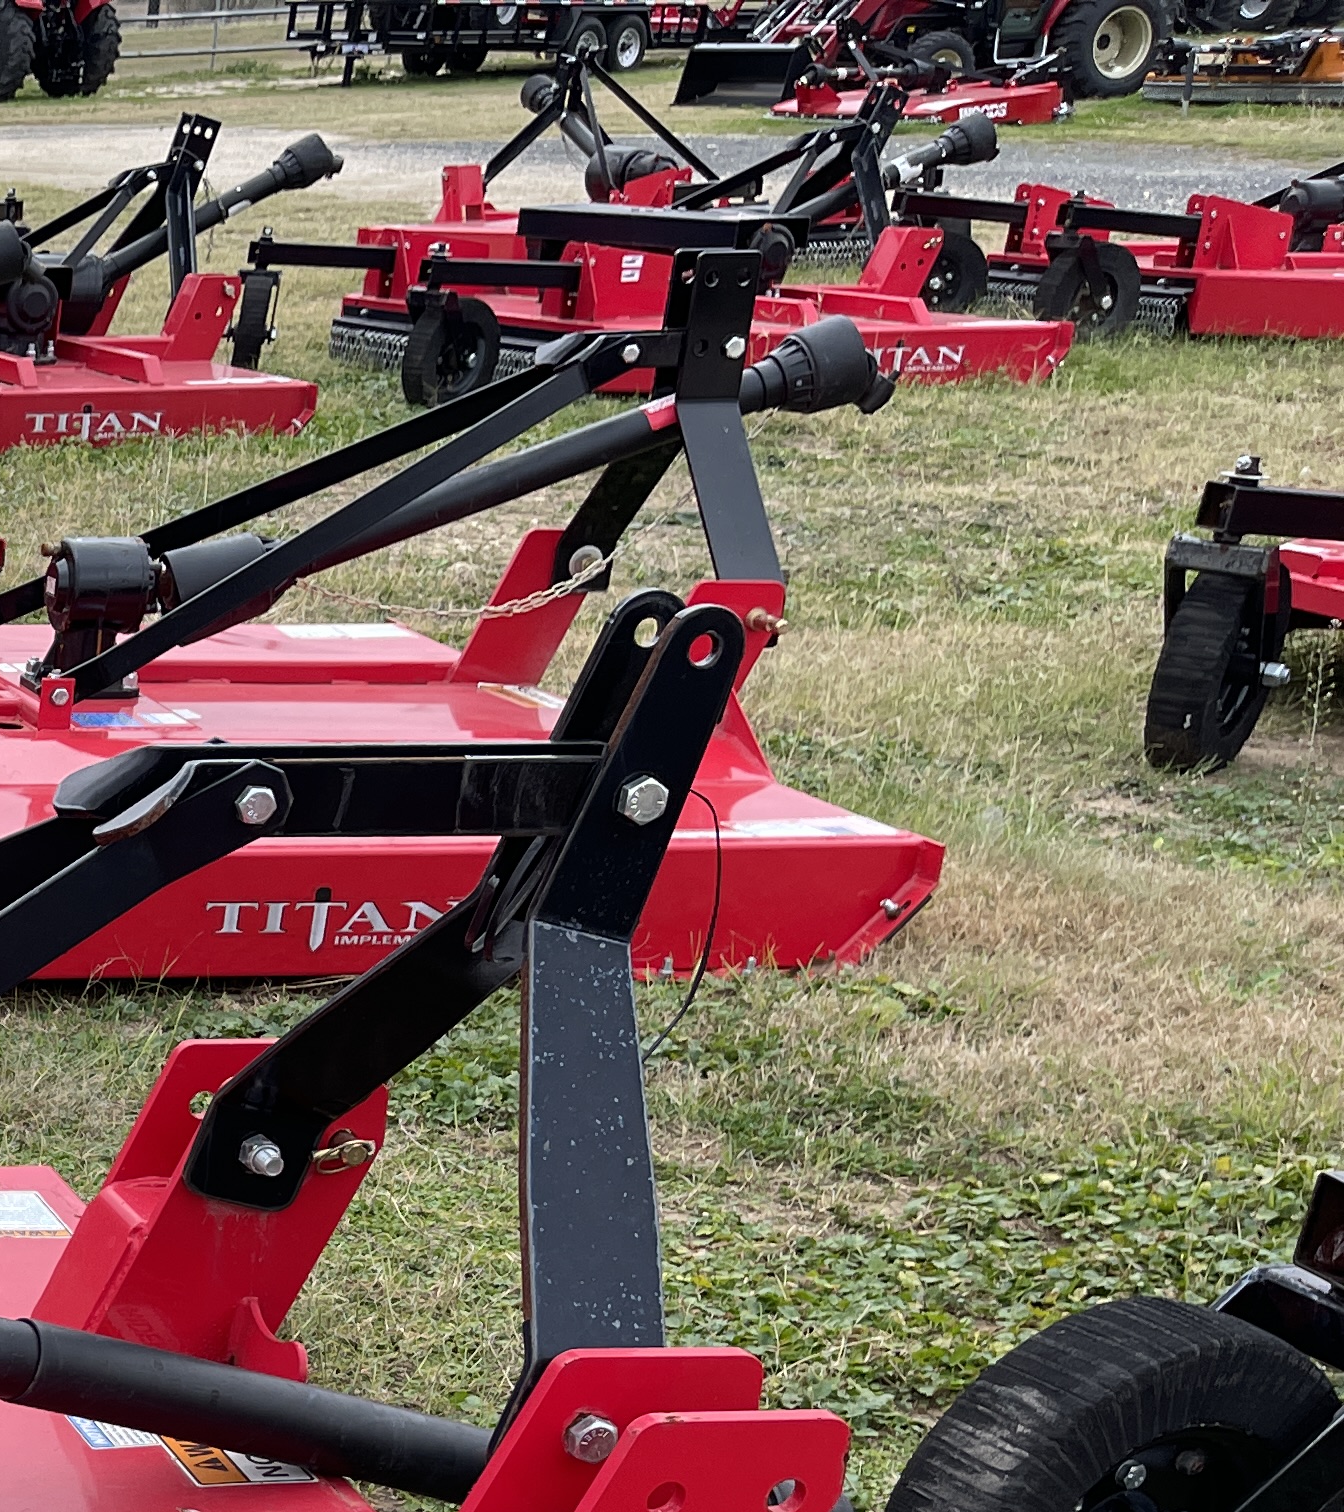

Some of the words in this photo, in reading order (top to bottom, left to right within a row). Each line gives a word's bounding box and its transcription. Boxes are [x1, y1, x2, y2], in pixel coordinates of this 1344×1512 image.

[865, 340, 965, 372] ITAN
[25, 405, 164, 440] TITAN
[206, 887, 464, 952] TITAN
[334, 935, 411, 946] IMPLEM
